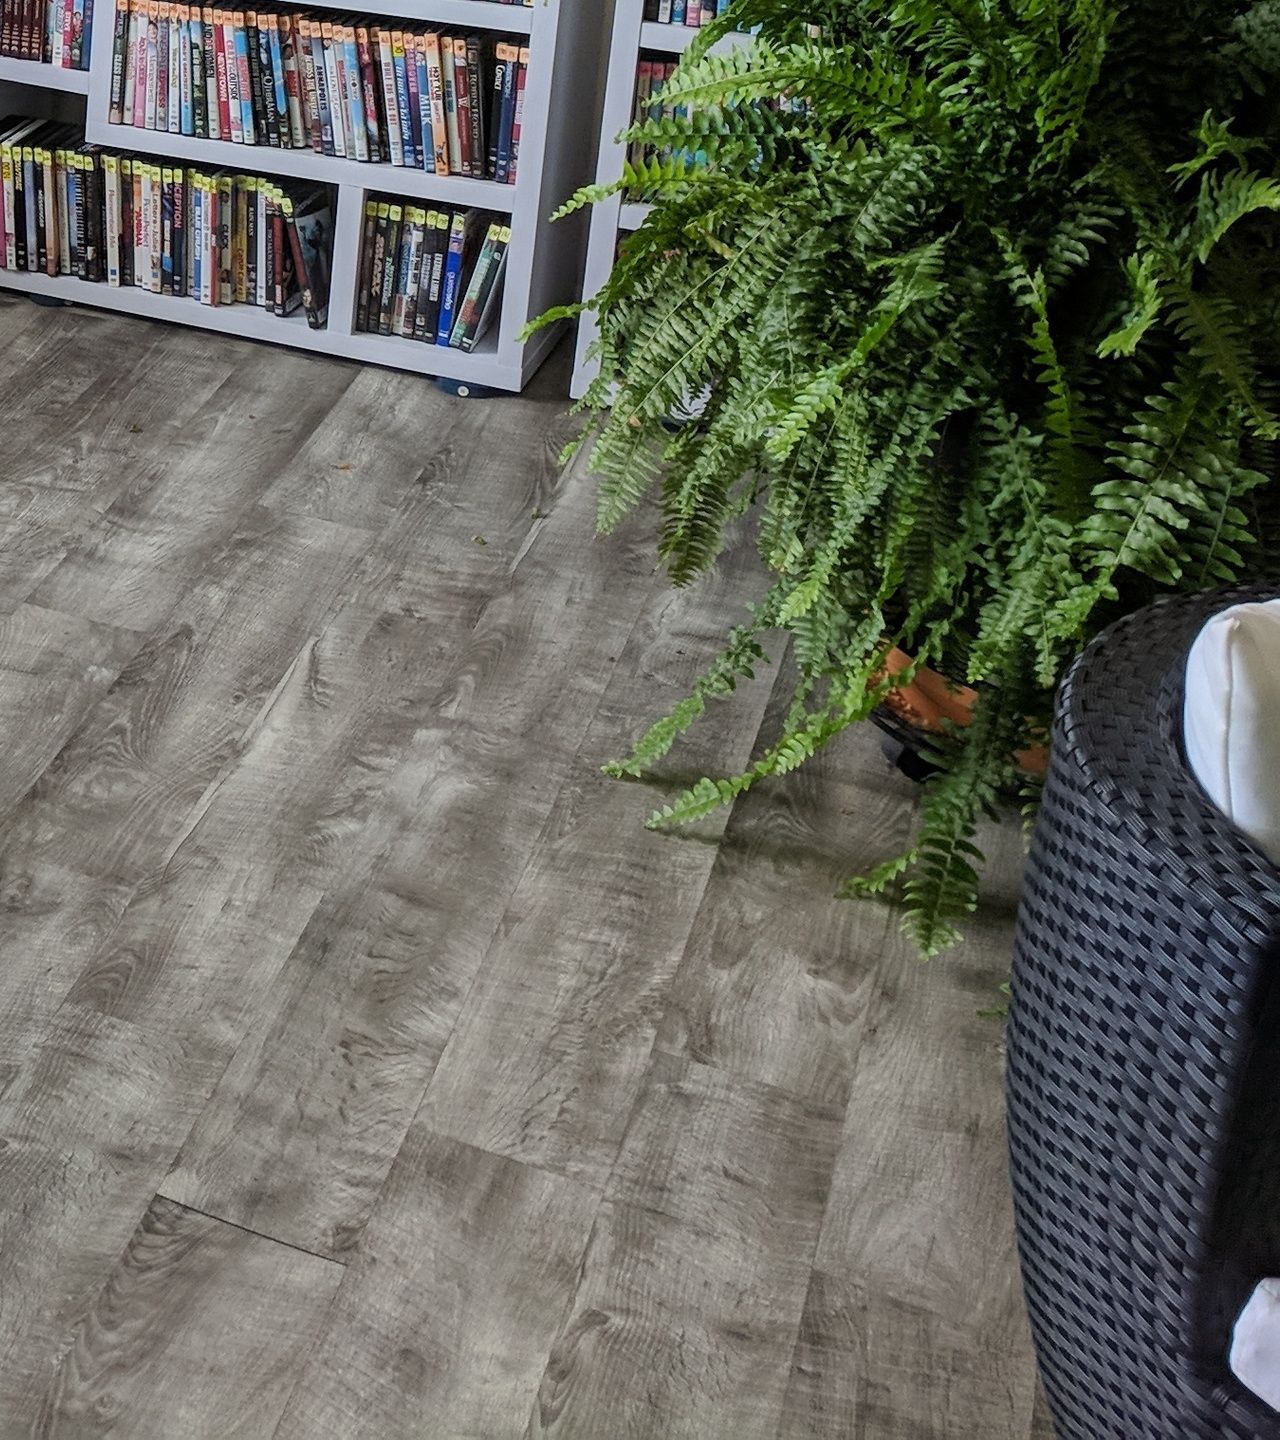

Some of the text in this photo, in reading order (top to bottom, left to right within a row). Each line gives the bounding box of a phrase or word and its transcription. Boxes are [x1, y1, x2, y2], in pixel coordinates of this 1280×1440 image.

[159, 69, 168, 109] EXPRESS
[229, 73, 239, 100] OUTSIDE
[316, 65, 327, 111] ANNAPOLIS
[420, 94, 430, 125] MILK
